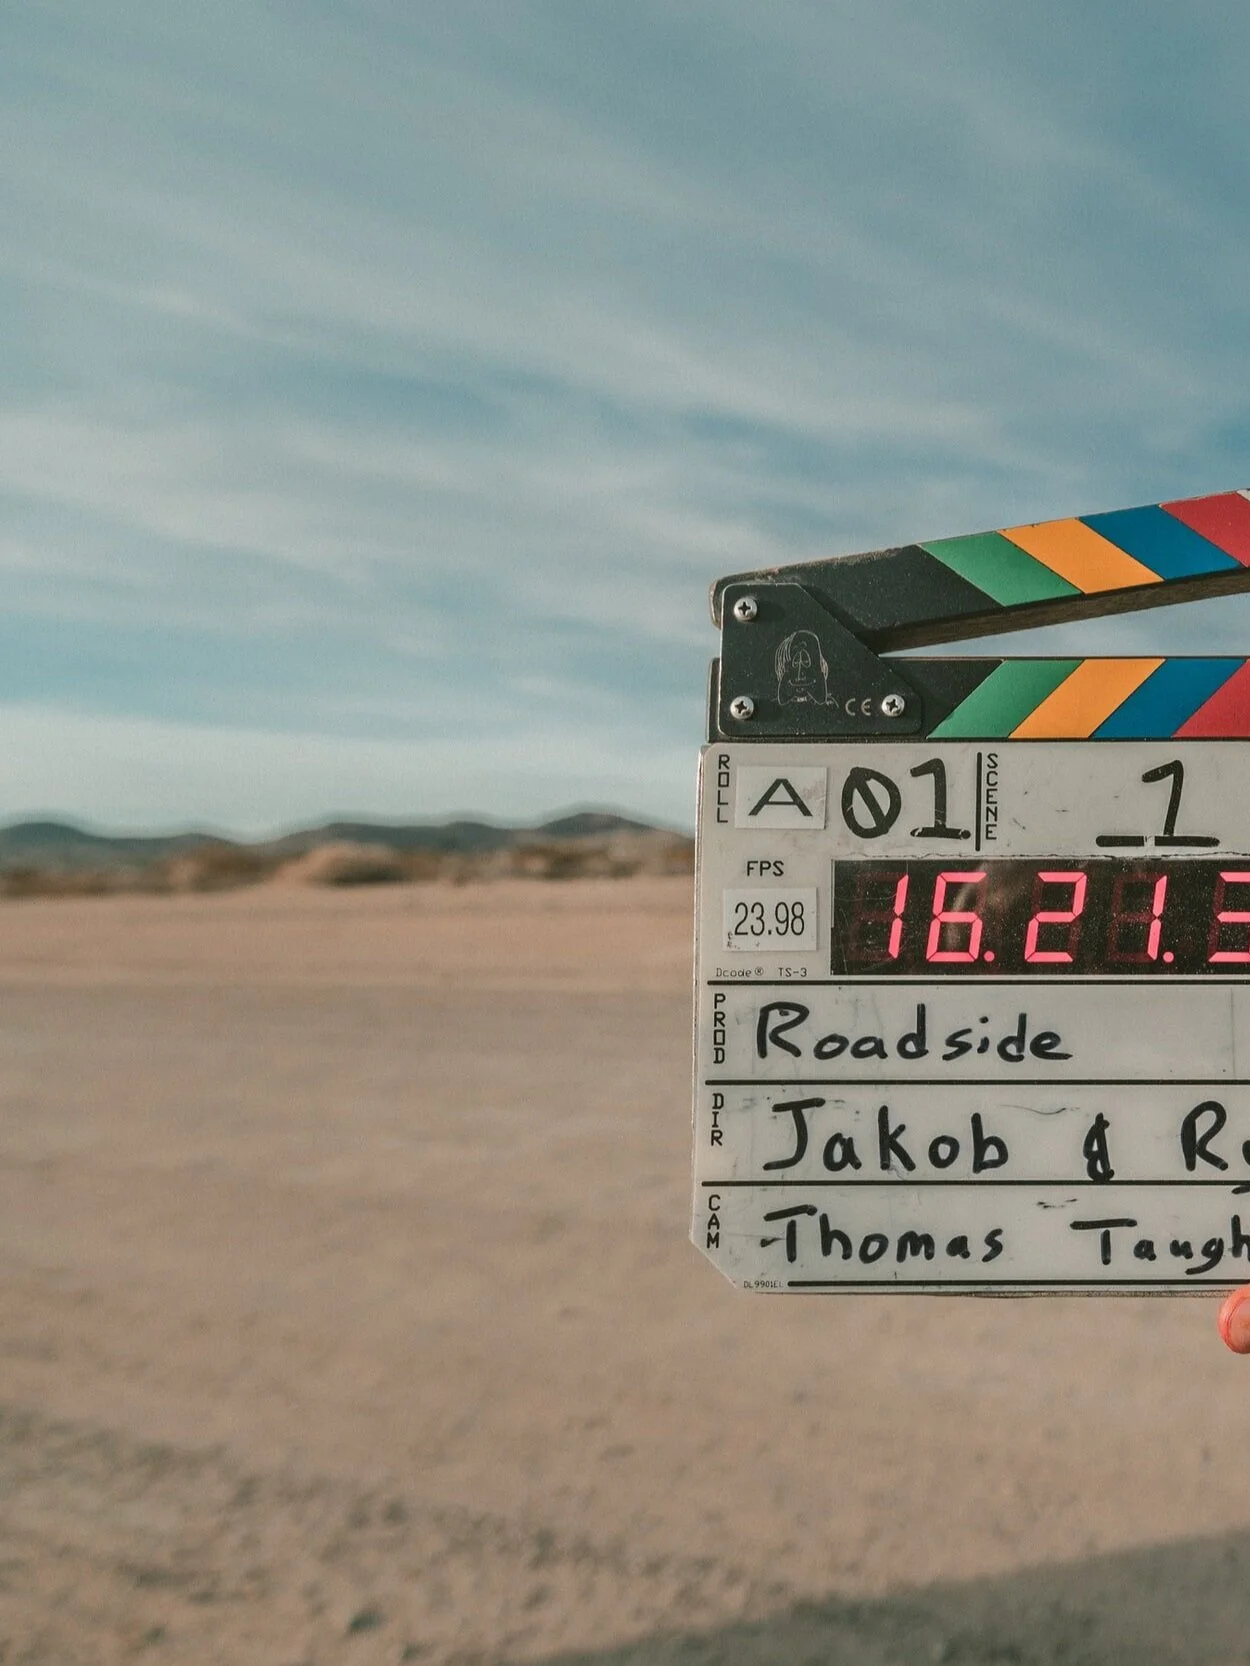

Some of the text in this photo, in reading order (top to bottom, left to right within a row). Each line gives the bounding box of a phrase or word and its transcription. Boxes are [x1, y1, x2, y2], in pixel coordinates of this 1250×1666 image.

[716, 754, 731, 824] ROLL
[749, 778, 813, 817] A
[985, 752, 999, 841] SCENE
[746, 860, 785, 877] FPS
[734, 901, 805, 937] 23.98
[777, 967, 808, 978] TS-3
[712, 992, 726, 1065] PROD
[756, 1001, 1074, 1063] Roadside
[710, 1092, 725, 1147] DIR
[762, 1097, 1009, 1175] Jakob
[706, 1194, 721, 1249] CAM
[760, 1204, 1004, 1265] Thomas
